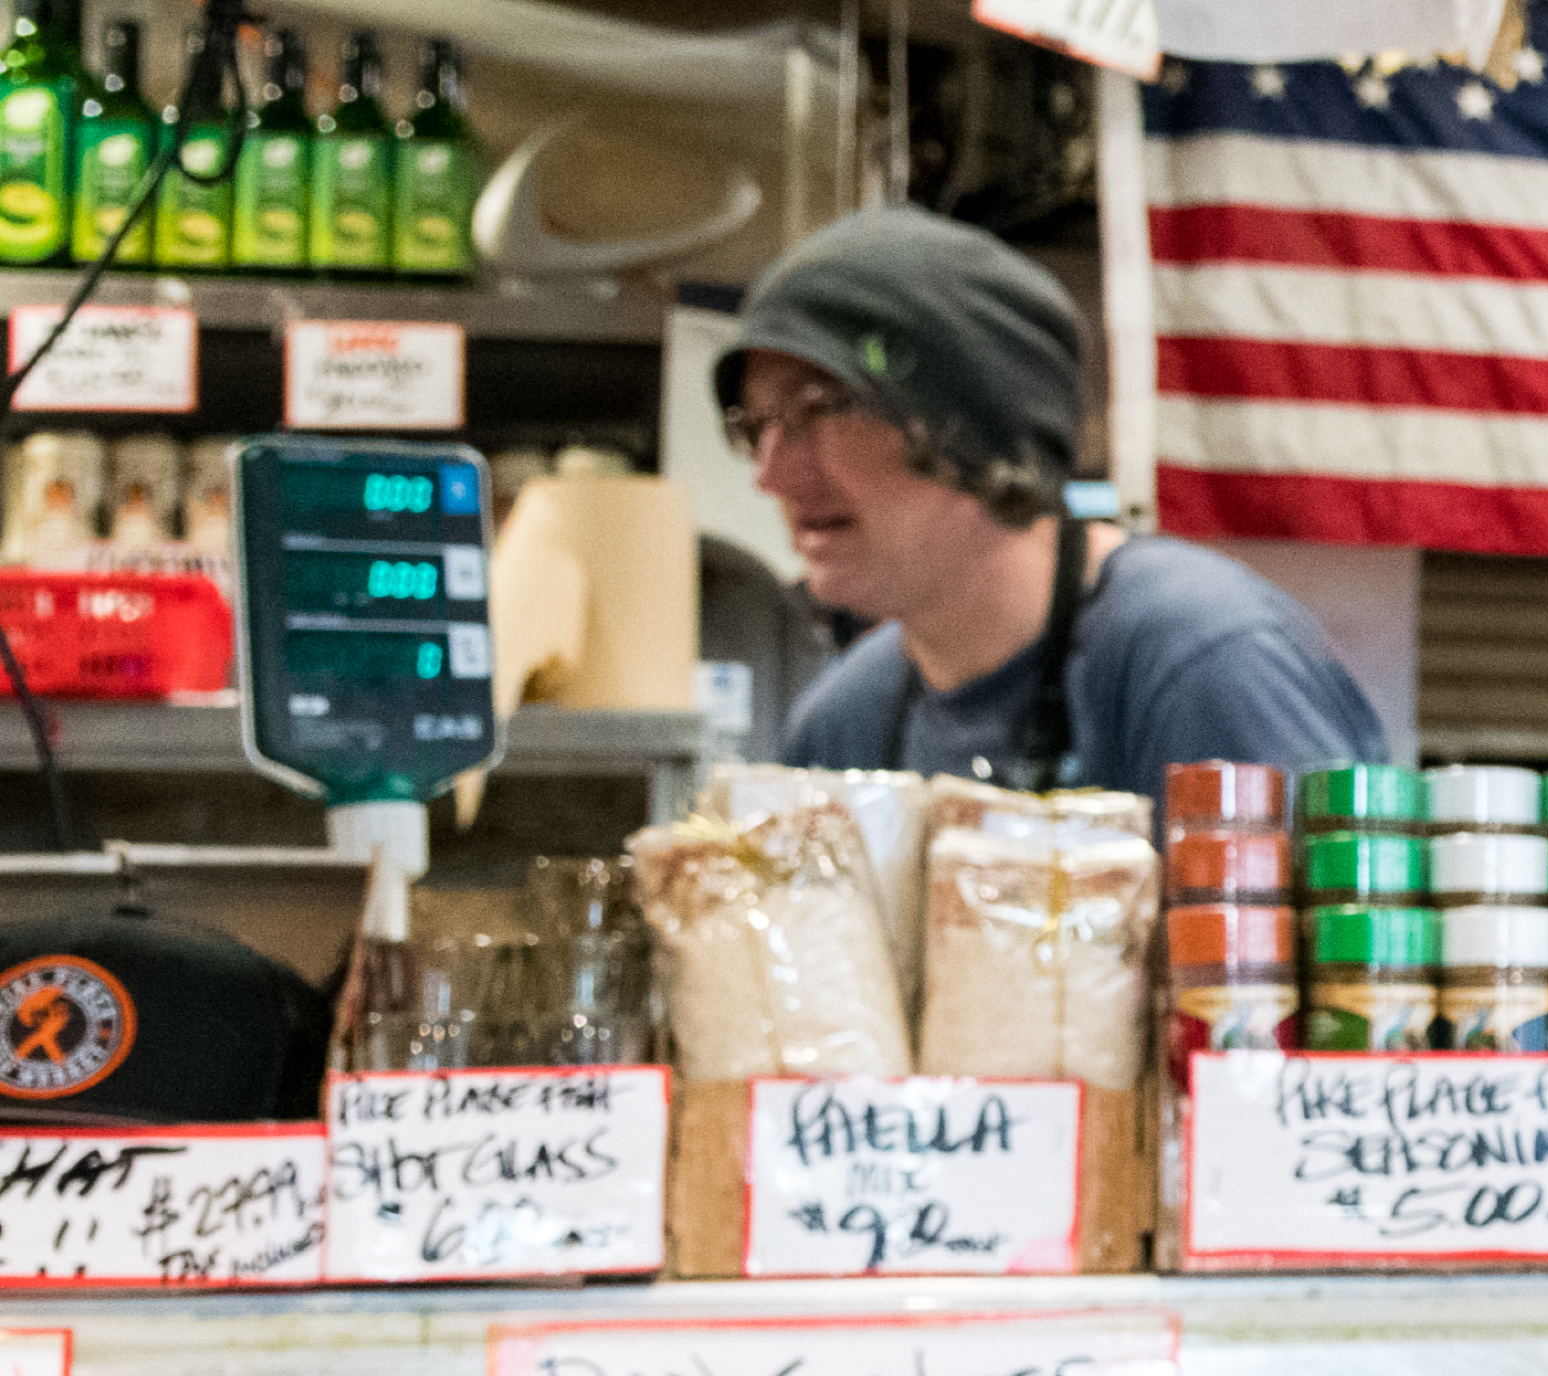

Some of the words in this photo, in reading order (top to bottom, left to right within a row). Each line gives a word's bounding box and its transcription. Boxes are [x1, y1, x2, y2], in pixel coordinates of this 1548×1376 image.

[788, 1080, 1029, 1165] PAELLA
[1276, 1058, 1377, 1129] PIKE
[1382, 1058, 1516, 1134] PLACE
[462, 1126, 618, 1184] GLASS
